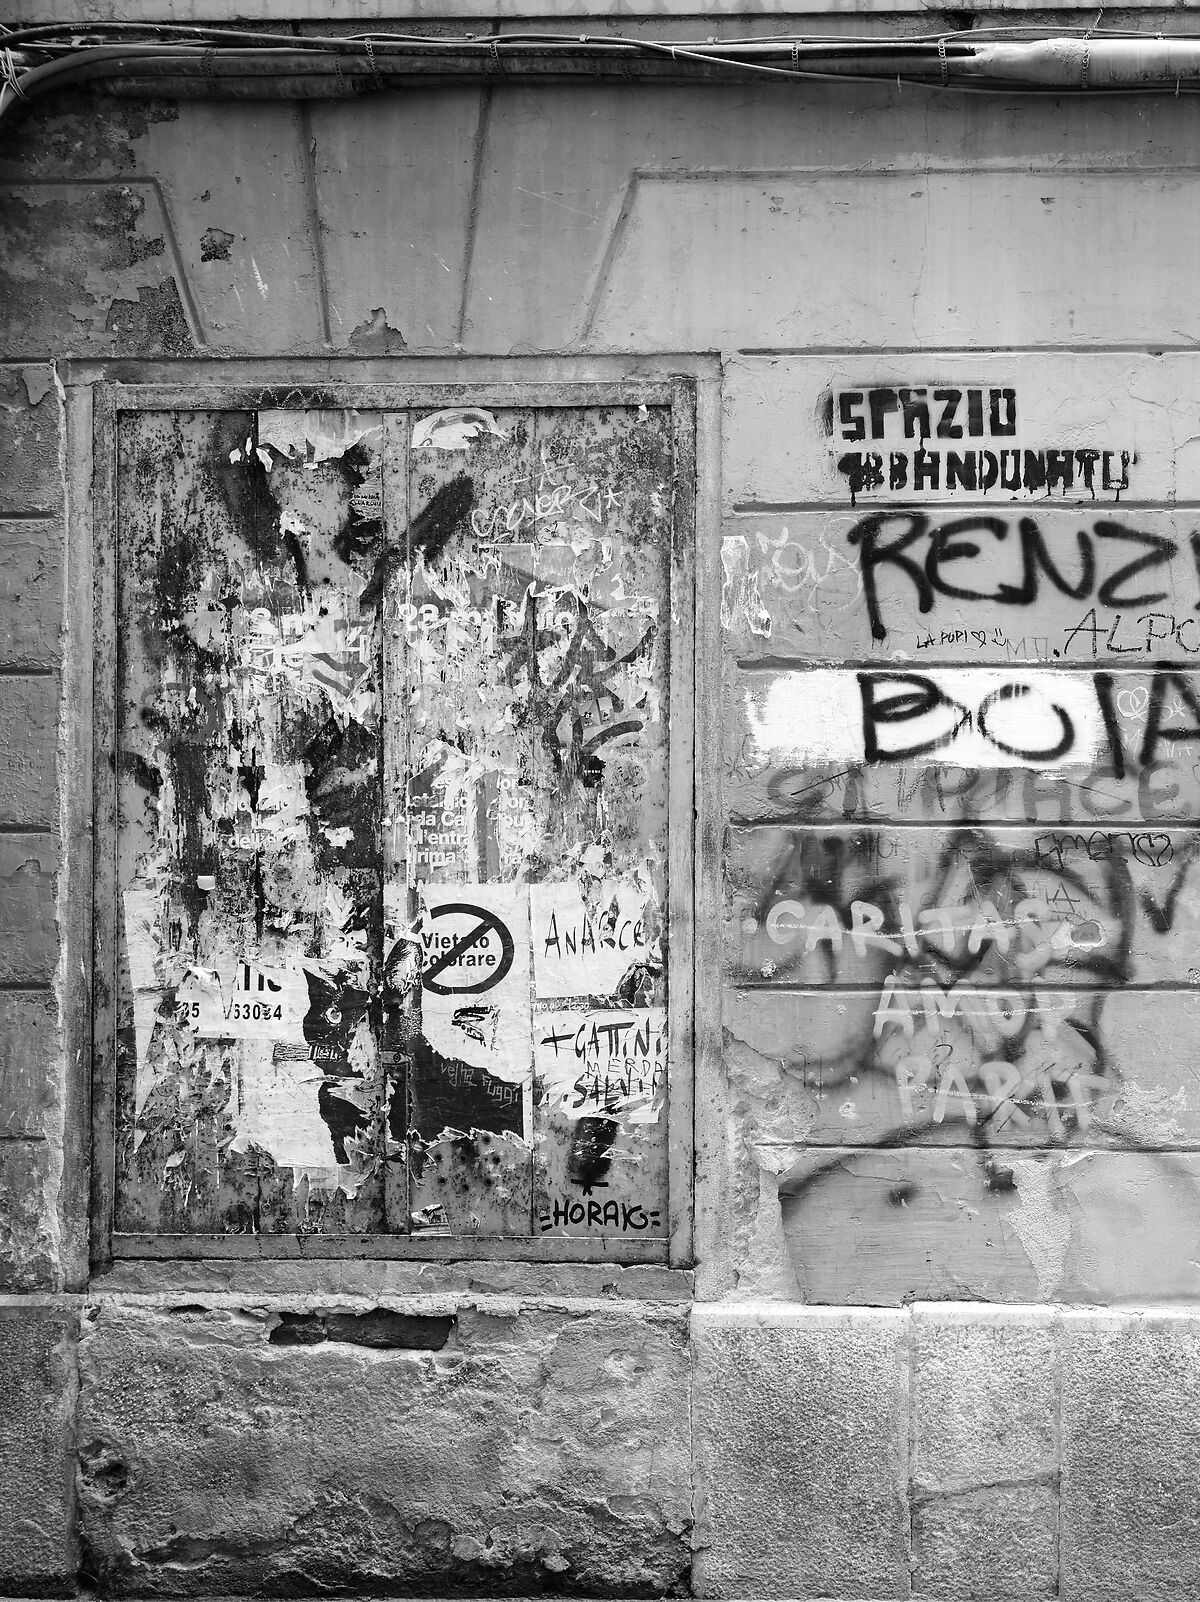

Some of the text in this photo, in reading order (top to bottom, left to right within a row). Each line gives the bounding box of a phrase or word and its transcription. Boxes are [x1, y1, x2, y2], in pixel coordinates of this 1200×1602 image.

[839, 388, 1017, 441] SPAZIO
[916, 635, 935, 649] LA
[421, 932, 490, 949] Vietto
[766, 899, 1054, 969] CARITAS
